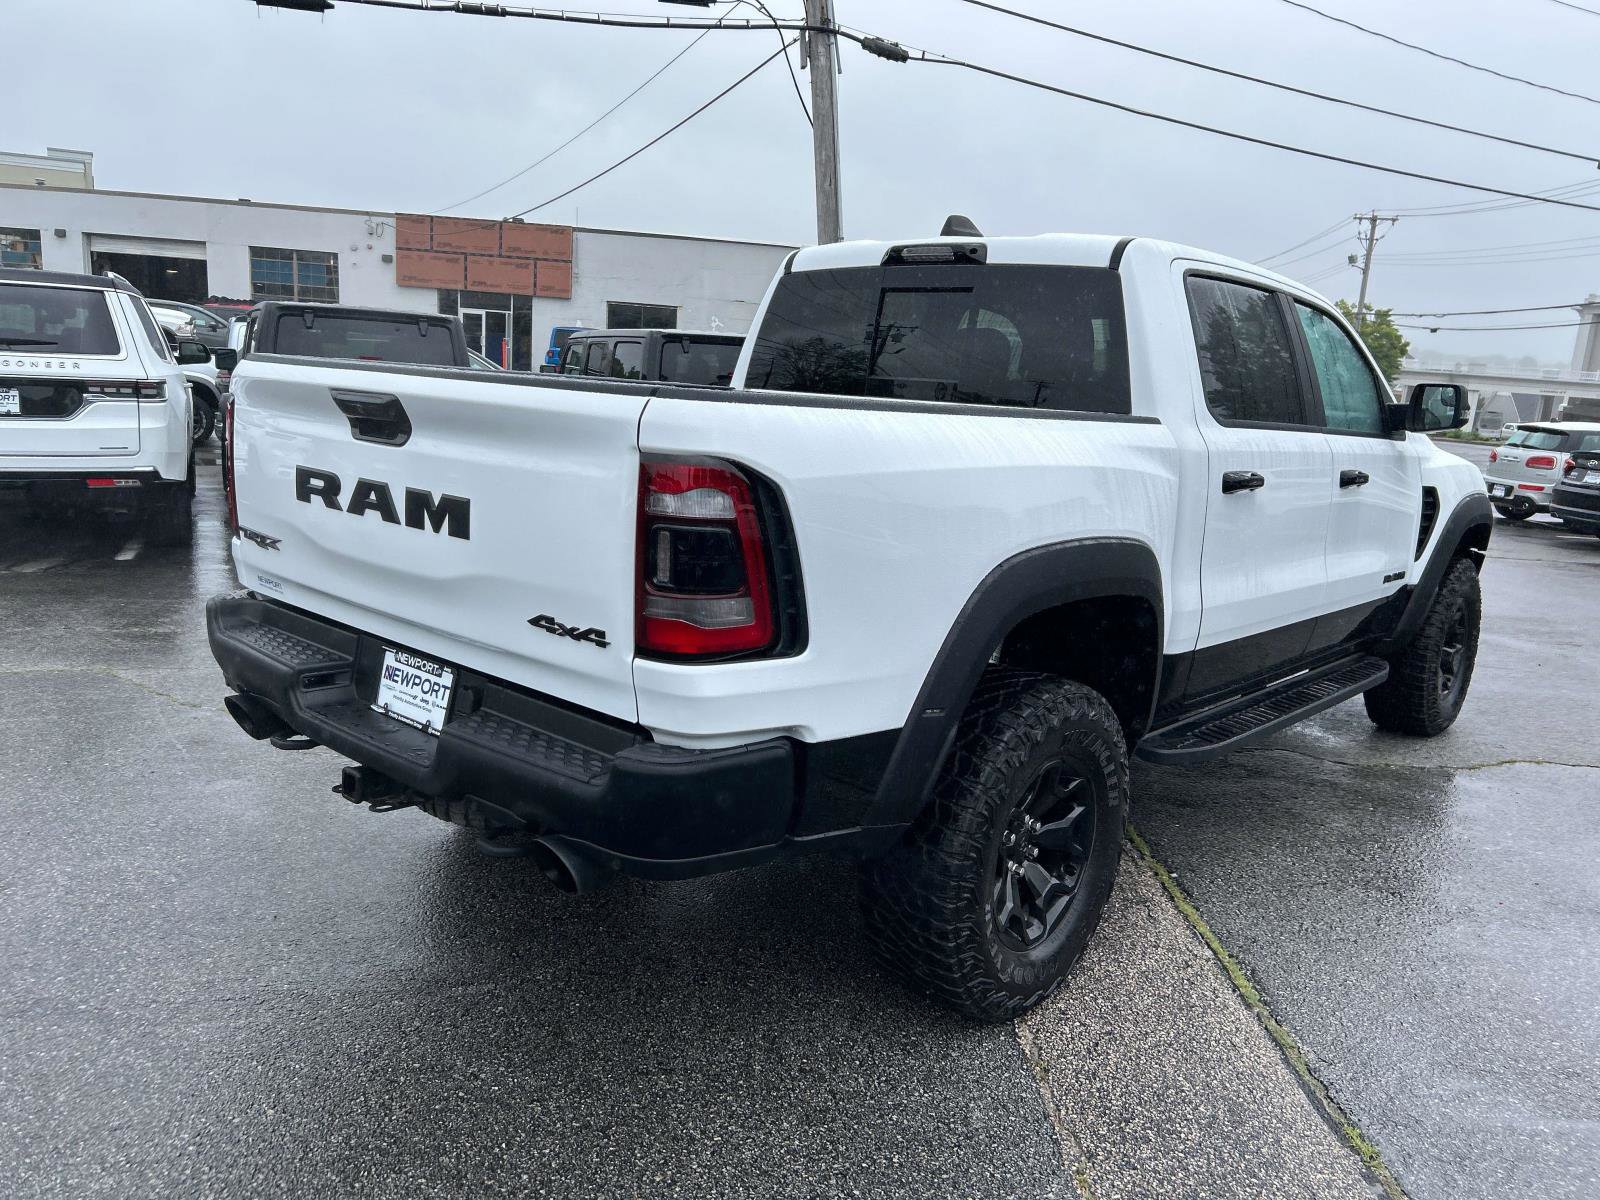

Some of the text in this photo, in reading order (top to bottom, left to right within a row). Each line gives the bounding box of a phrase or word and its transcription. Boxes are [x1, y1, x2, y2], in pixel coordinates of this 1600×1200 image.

[296, 464, 471, 541] RAM
[383, 663, 451, 701] NEWPORT
[397, 651, 439, 675] NEWPORT
